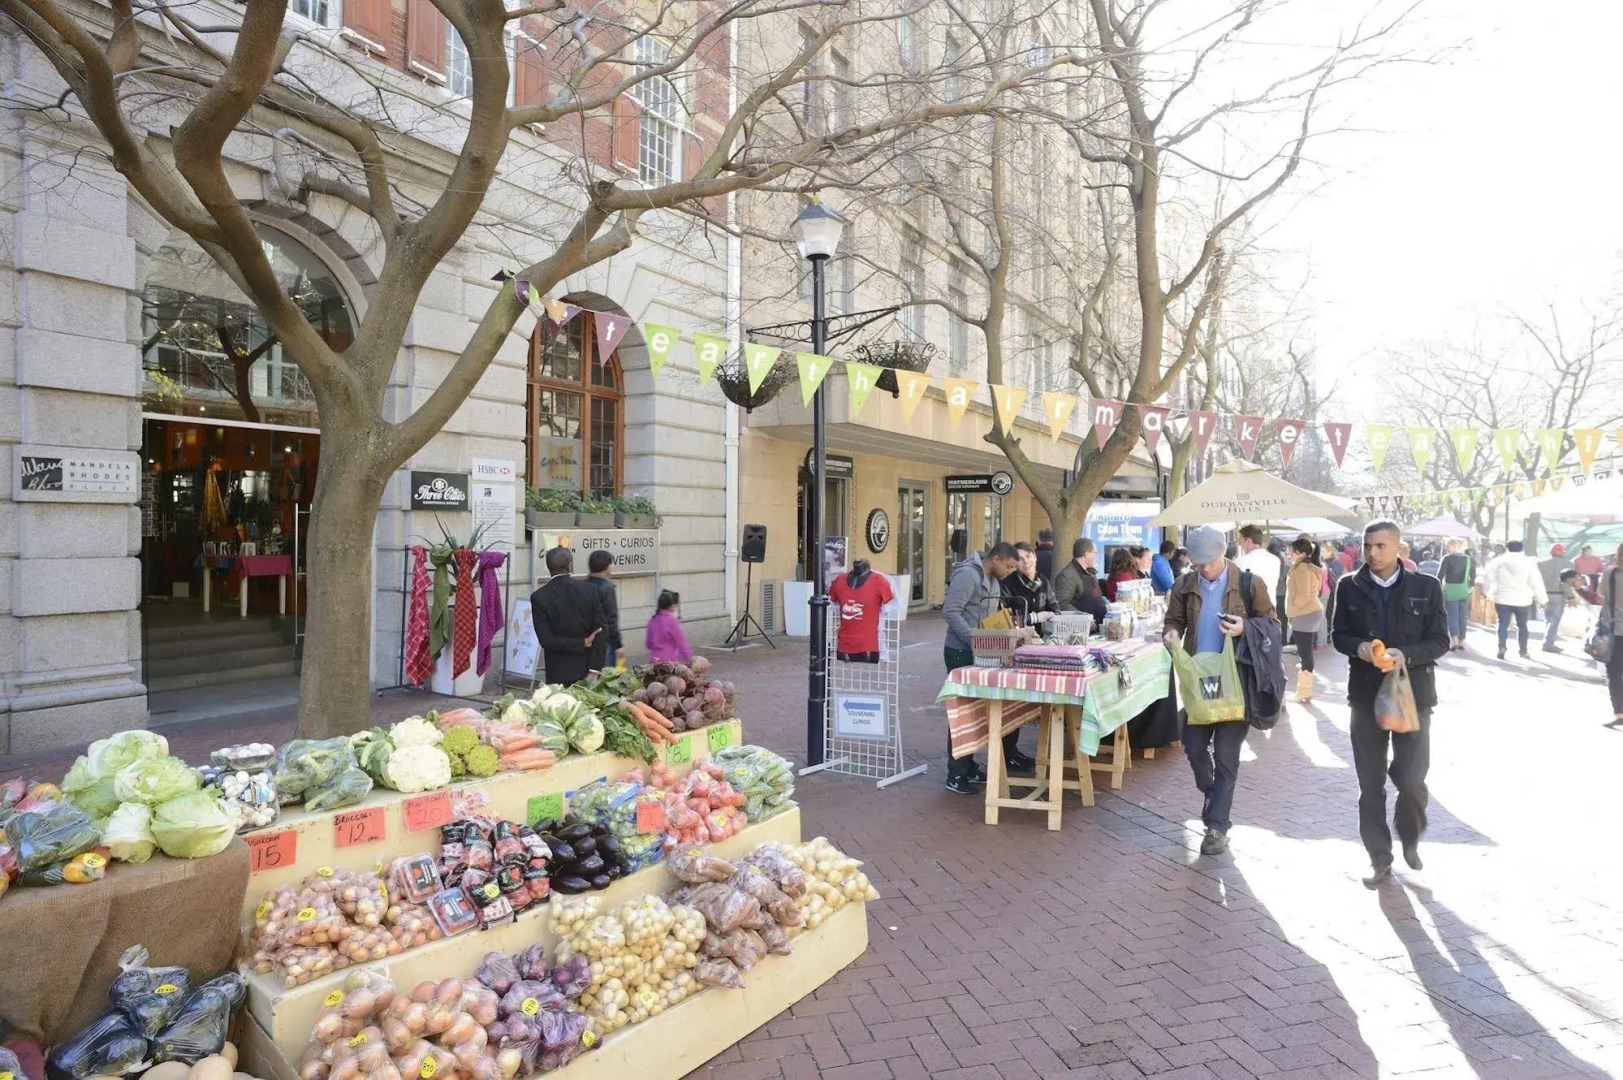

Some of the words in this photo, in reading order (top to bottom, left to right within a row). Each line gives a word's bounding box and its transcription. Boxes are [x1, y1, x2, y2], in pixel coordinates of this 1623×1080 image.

[70, 461, 130, 470] MANDELA
[478, 465, 499, 474] HSBC
[70, 472, 130, 480] RHODES
[414, 485, 442, 500] Three
[443, 486, 466, 501] Cities
[1201, 498, 1288, 508] DURBANVILLE
[582, 538, 610, 549] GIFTS
[620, 537, 654, 548] CURIOS
[612, 554, 646, 565] VENIRS
[1203, 682, 1219, 693] W
[349, 822, 365, 843] 12
[257, 844, 282, 869] 15
[524, 999, 536, 1014] R10
